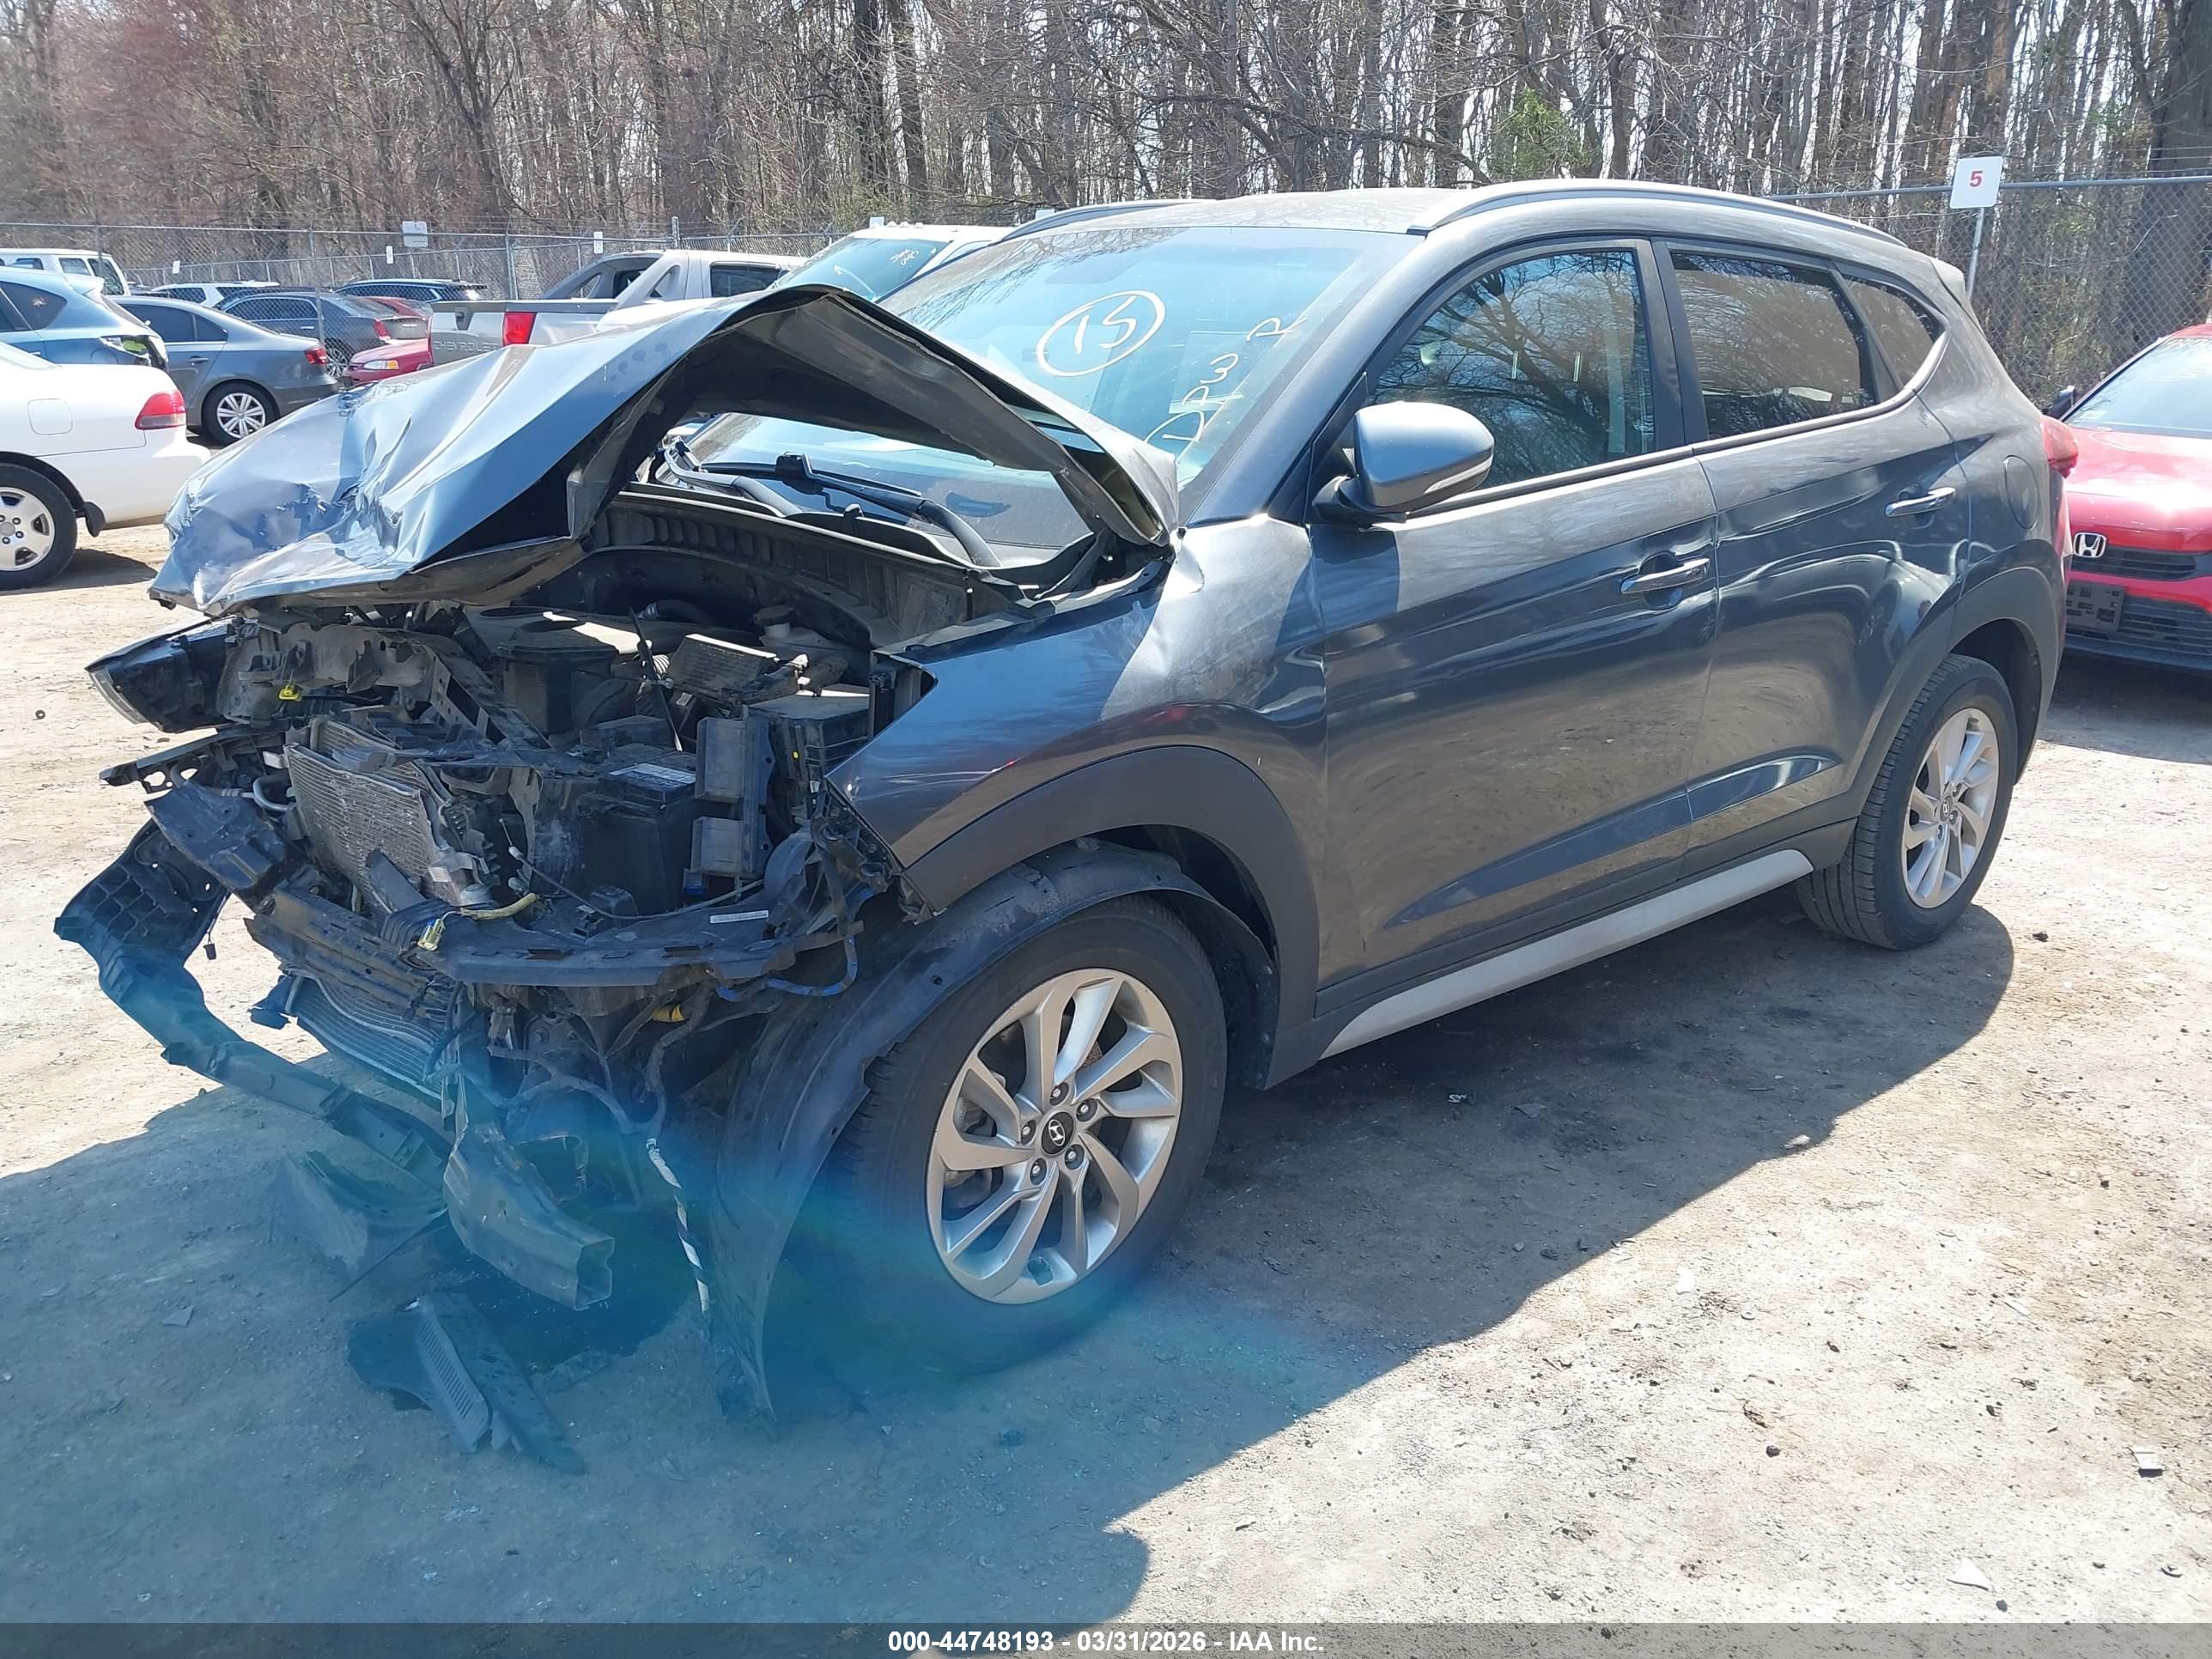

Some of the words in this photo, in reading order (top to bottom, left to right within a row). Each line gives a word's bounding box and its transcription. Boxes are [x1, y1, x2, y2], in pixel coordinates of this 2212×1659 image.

[1969, 170, 1984, 188] 5
[1073, 295, 1138, 355] 15
[433, 340, 499, 352] CHEVROLET
